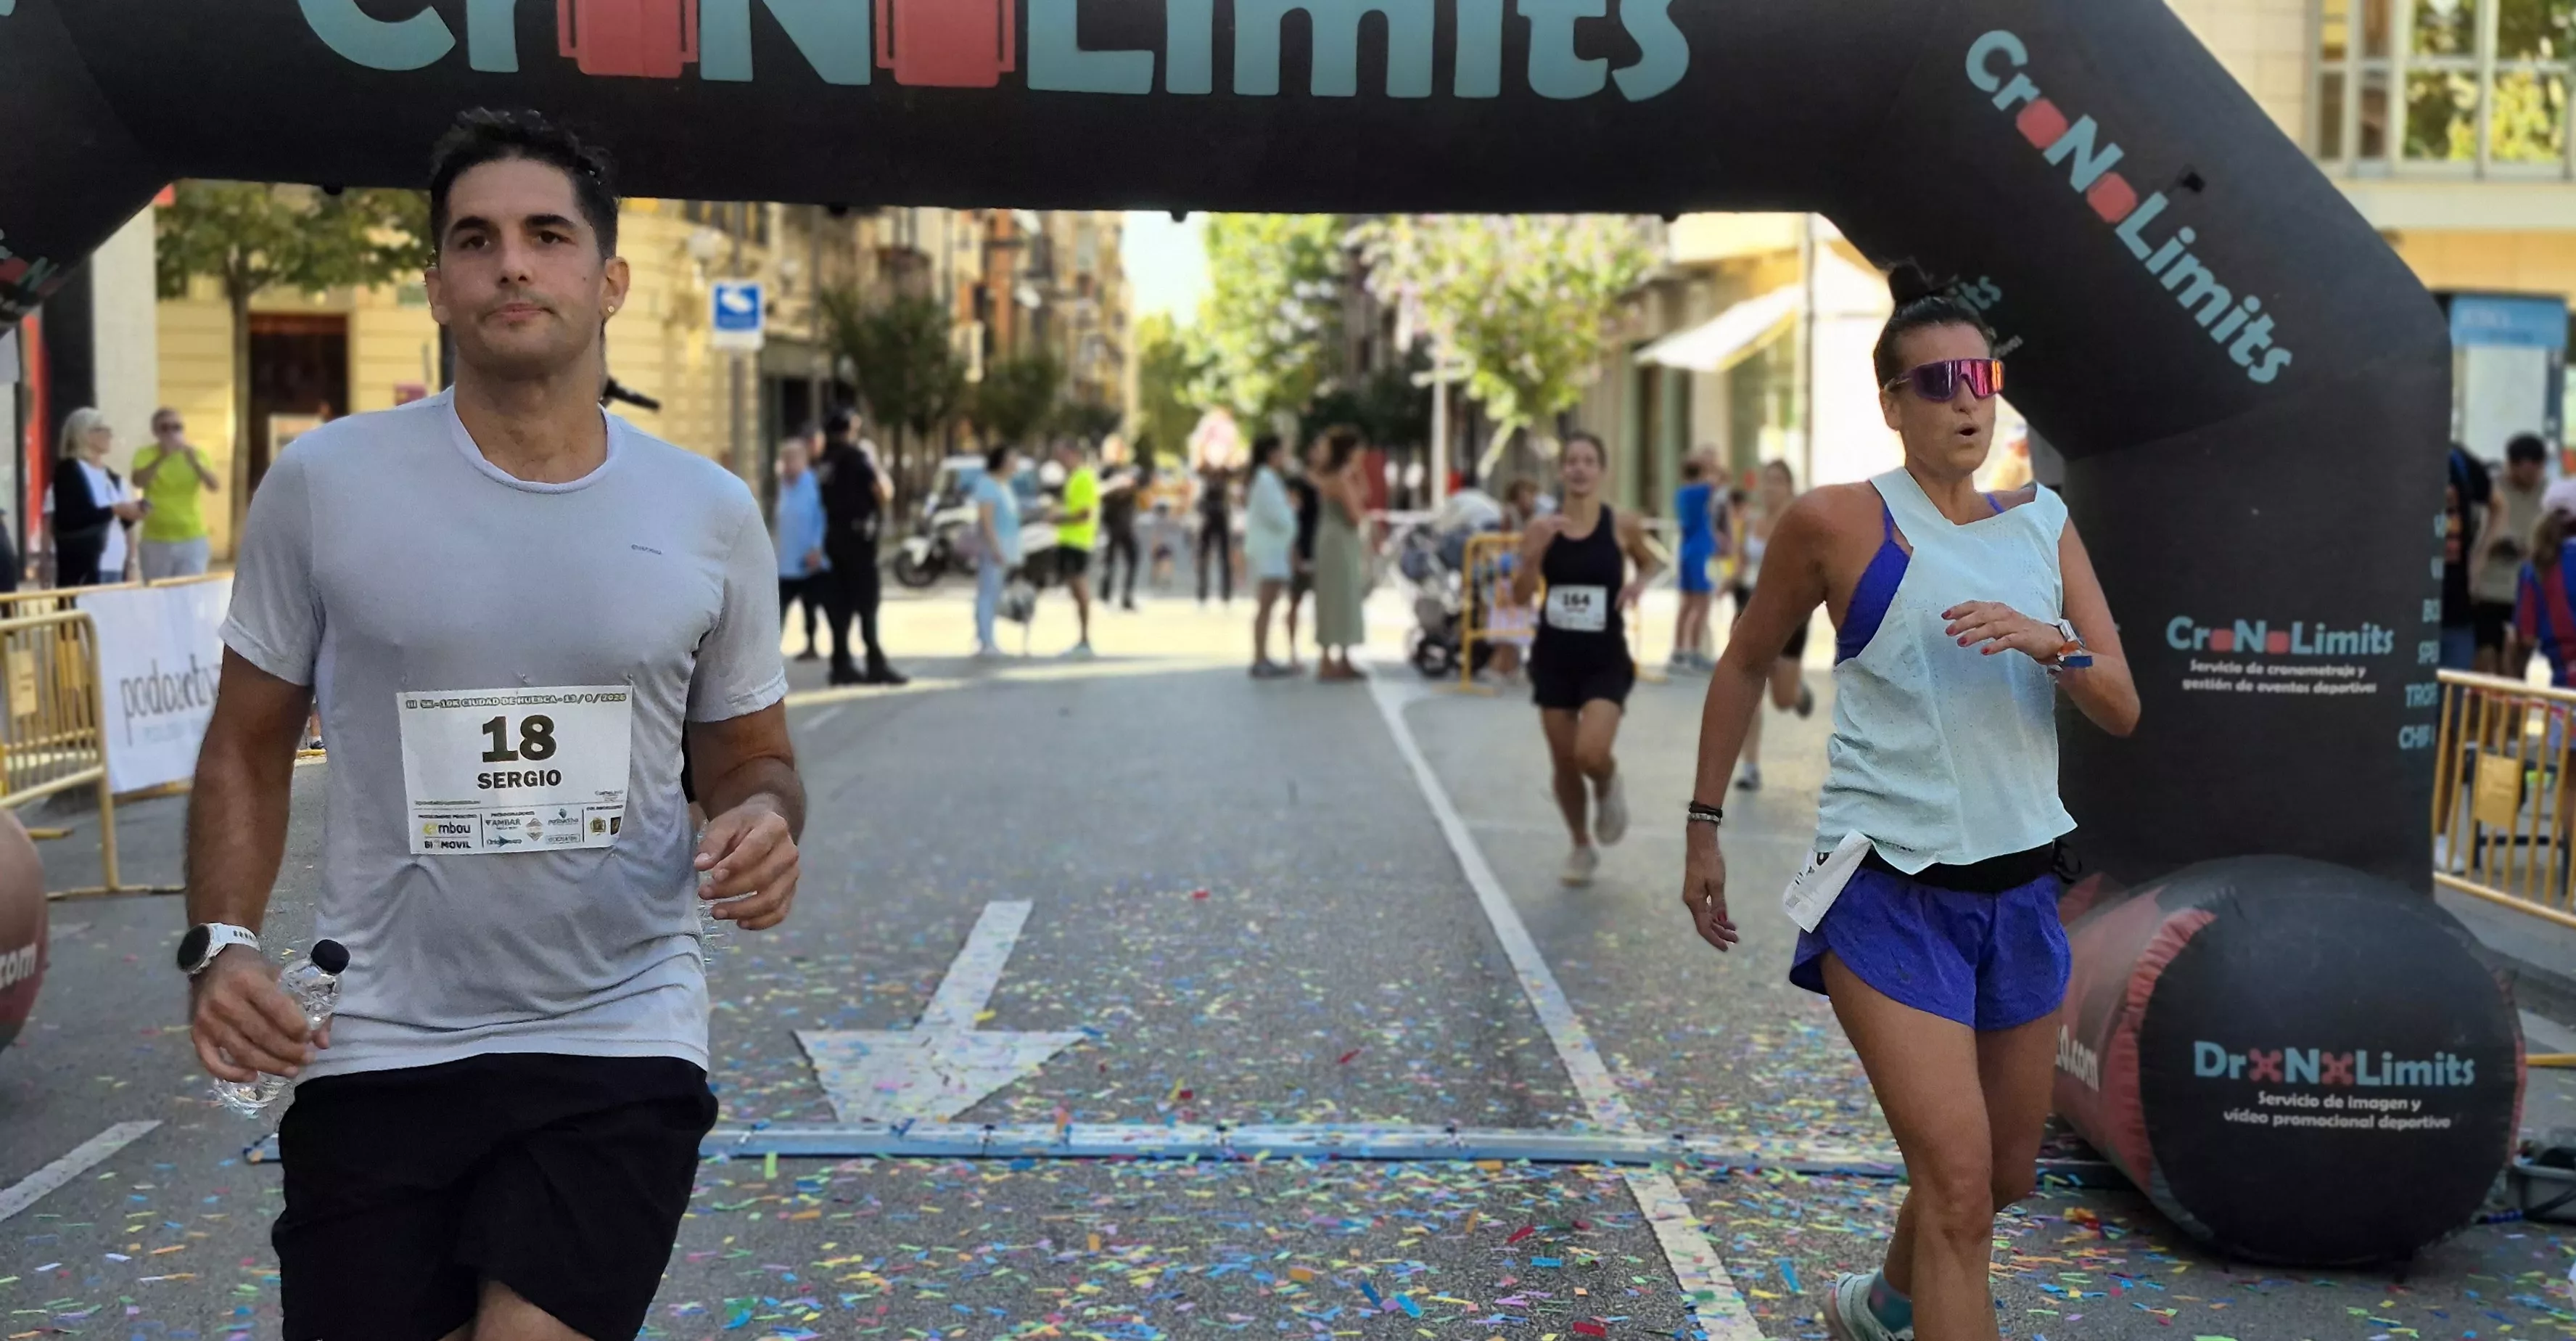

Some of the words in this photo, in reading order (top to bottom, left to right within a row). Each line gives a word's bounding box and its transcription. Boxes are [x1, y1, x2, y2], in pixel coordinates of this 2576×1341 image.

[2190, 659, 2242, 674] Servicio
[2246, 662, 2264, 675] de
[2267, 663, 2355, 678] cronometraje
[2357, 666, 2366, 678] y
[2182, 678, 2232, 691] gestión
[2235, 679, 2253, 692] de
[2257, 681, 2310, 694] eventos
[461, 697, 500, 707] CIUDAD
[501, 697, 516, 705] DE
[517, 695, 557, 705] HUESCA
[482, 715, 556, 763] 18
[477, 769, 561, 790] SERGIO
[2258, 1091, 2319, 1108] Servicio
[2324, 1094, 2344, 1109] de
[2347, 1095, 2408, 1112] imagen
[2411, 1099, 2421, 1112] y
[2273, 1111, 2374, 1128] promocional
[2378, 1115, 2451, 1132] deportivo
